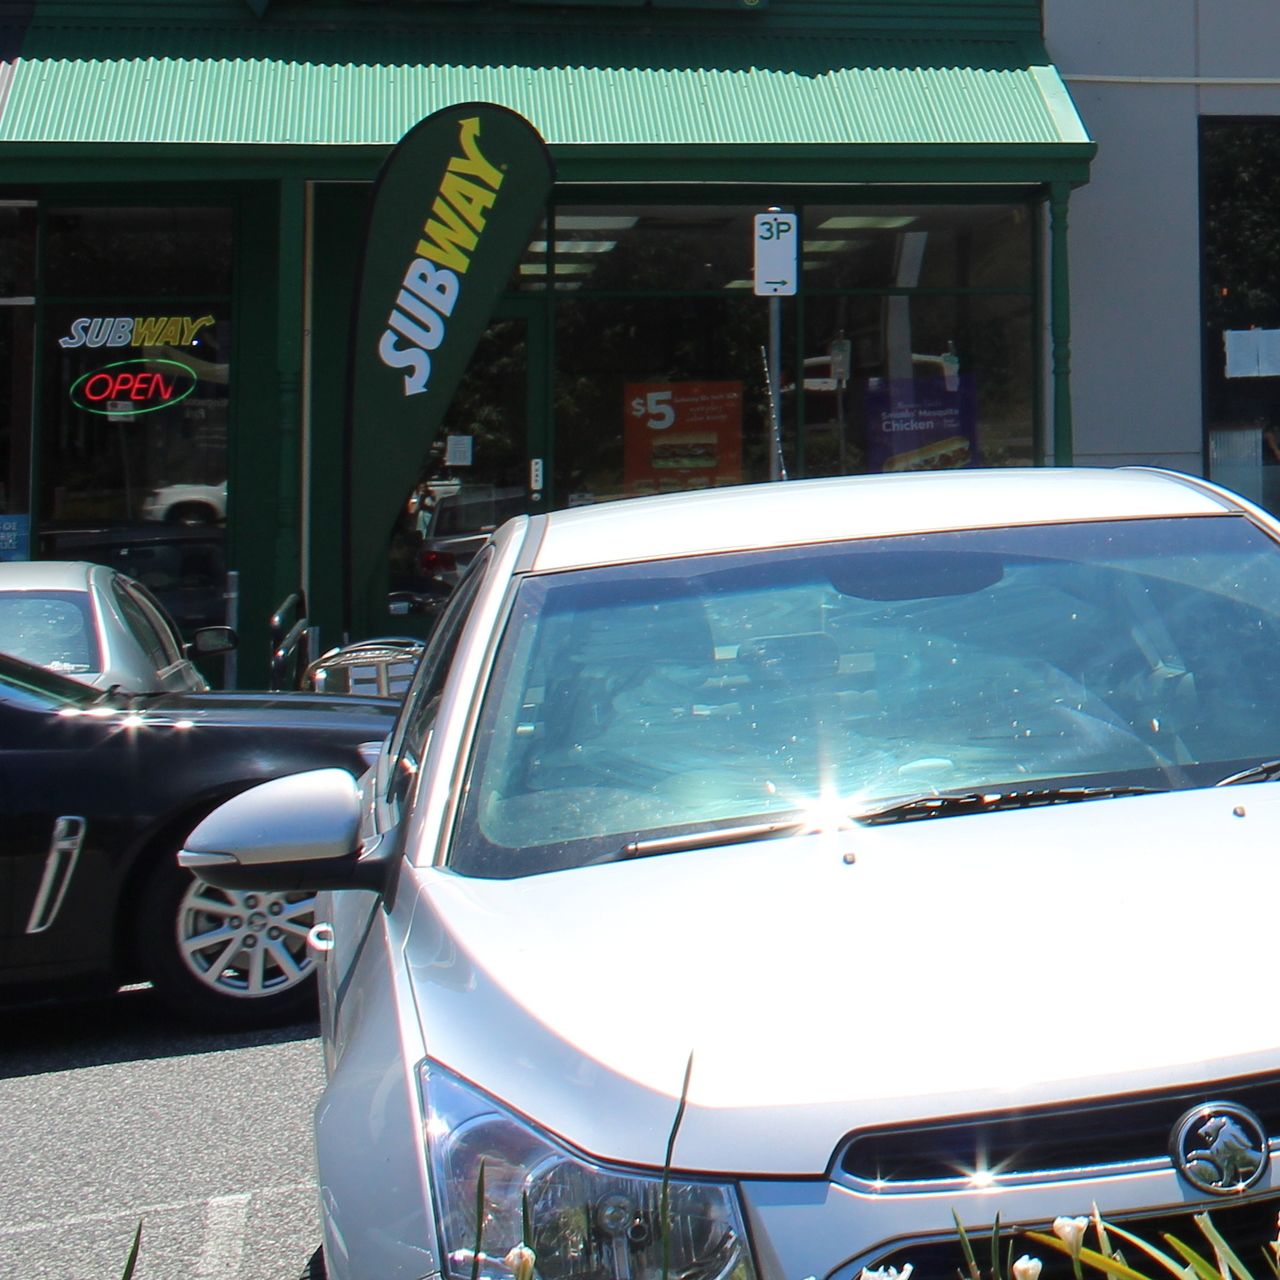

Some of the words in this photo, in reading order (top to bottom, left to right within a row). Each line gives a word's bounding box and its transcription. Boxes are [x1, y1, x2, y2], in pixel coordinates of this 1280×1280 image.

[759, 221, 792, 240] 3P
[378, 117, 505, 396] SUBWAY
[58, 315, 215, 348] SUBWAY
[84, 373, 175, 400] OPEN
[631, 391, 676, 430] $5
[882, 419, 935, 432] Chicken
